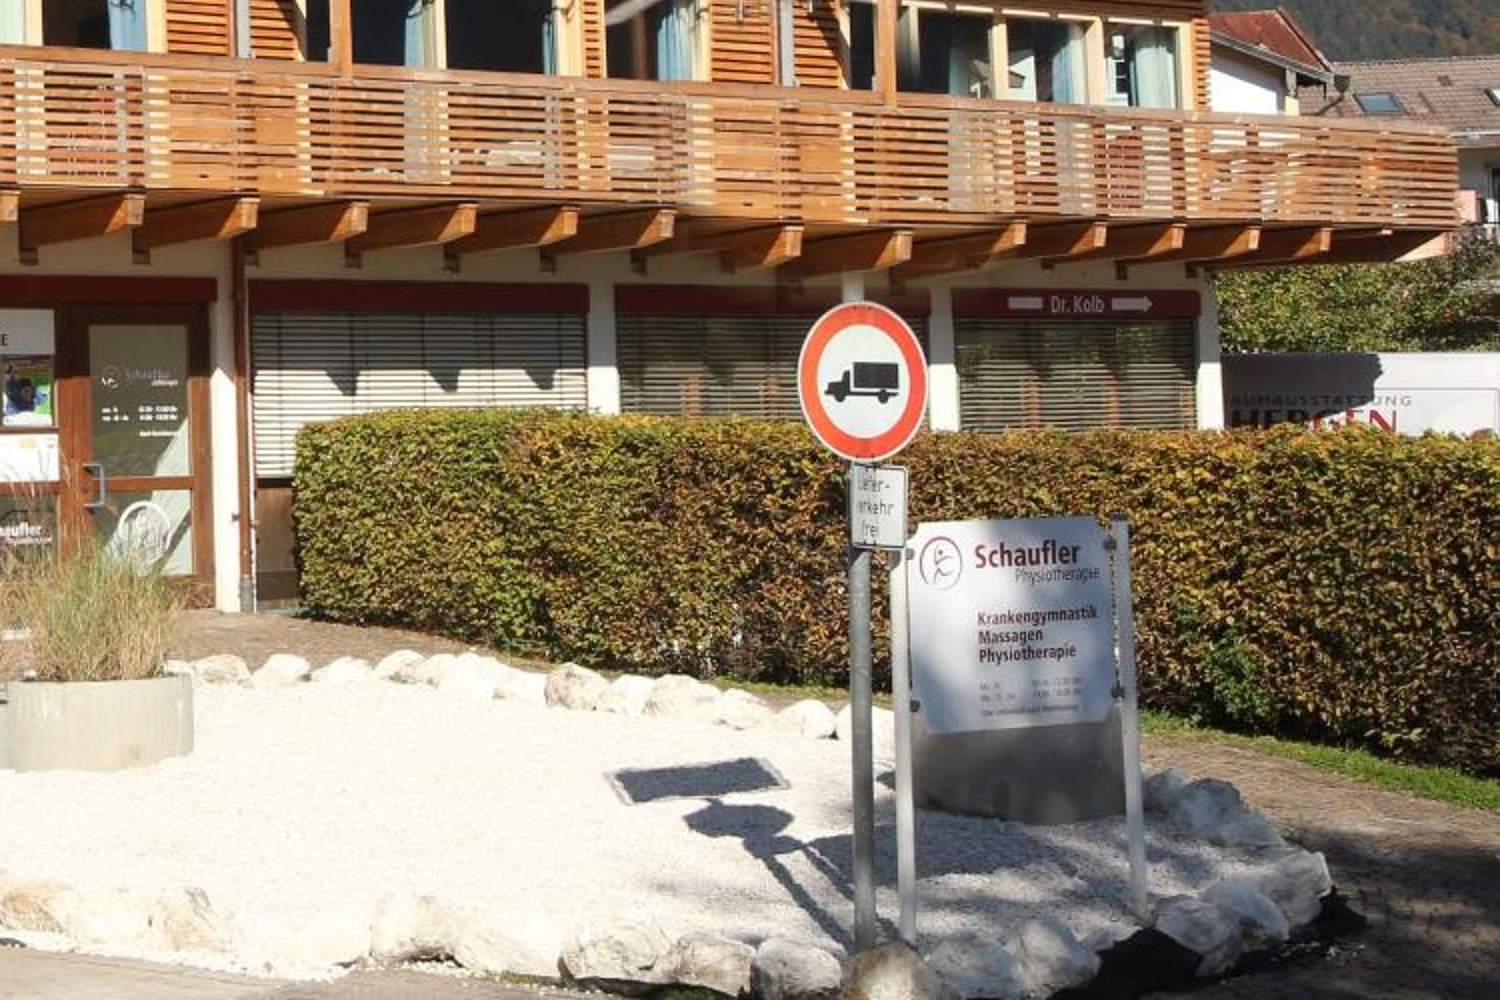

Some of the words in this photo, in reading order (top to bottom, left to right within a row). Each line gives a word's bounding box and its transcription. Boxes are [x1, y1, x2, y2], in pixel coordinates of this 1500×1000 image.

[1051, 295, 1070, 313] Dr.
[1073, 295, 1105, 313] Kolb
[974, 539, 1082, 569] Schaufler
[1015, 566, 1101, 586] Physiotherapie
[977, 604, 1099, 627] Krankengymnastik
[978, 628, 1044, 646] Massagen
[979, 641, 1078, 666] Physiotherapie
